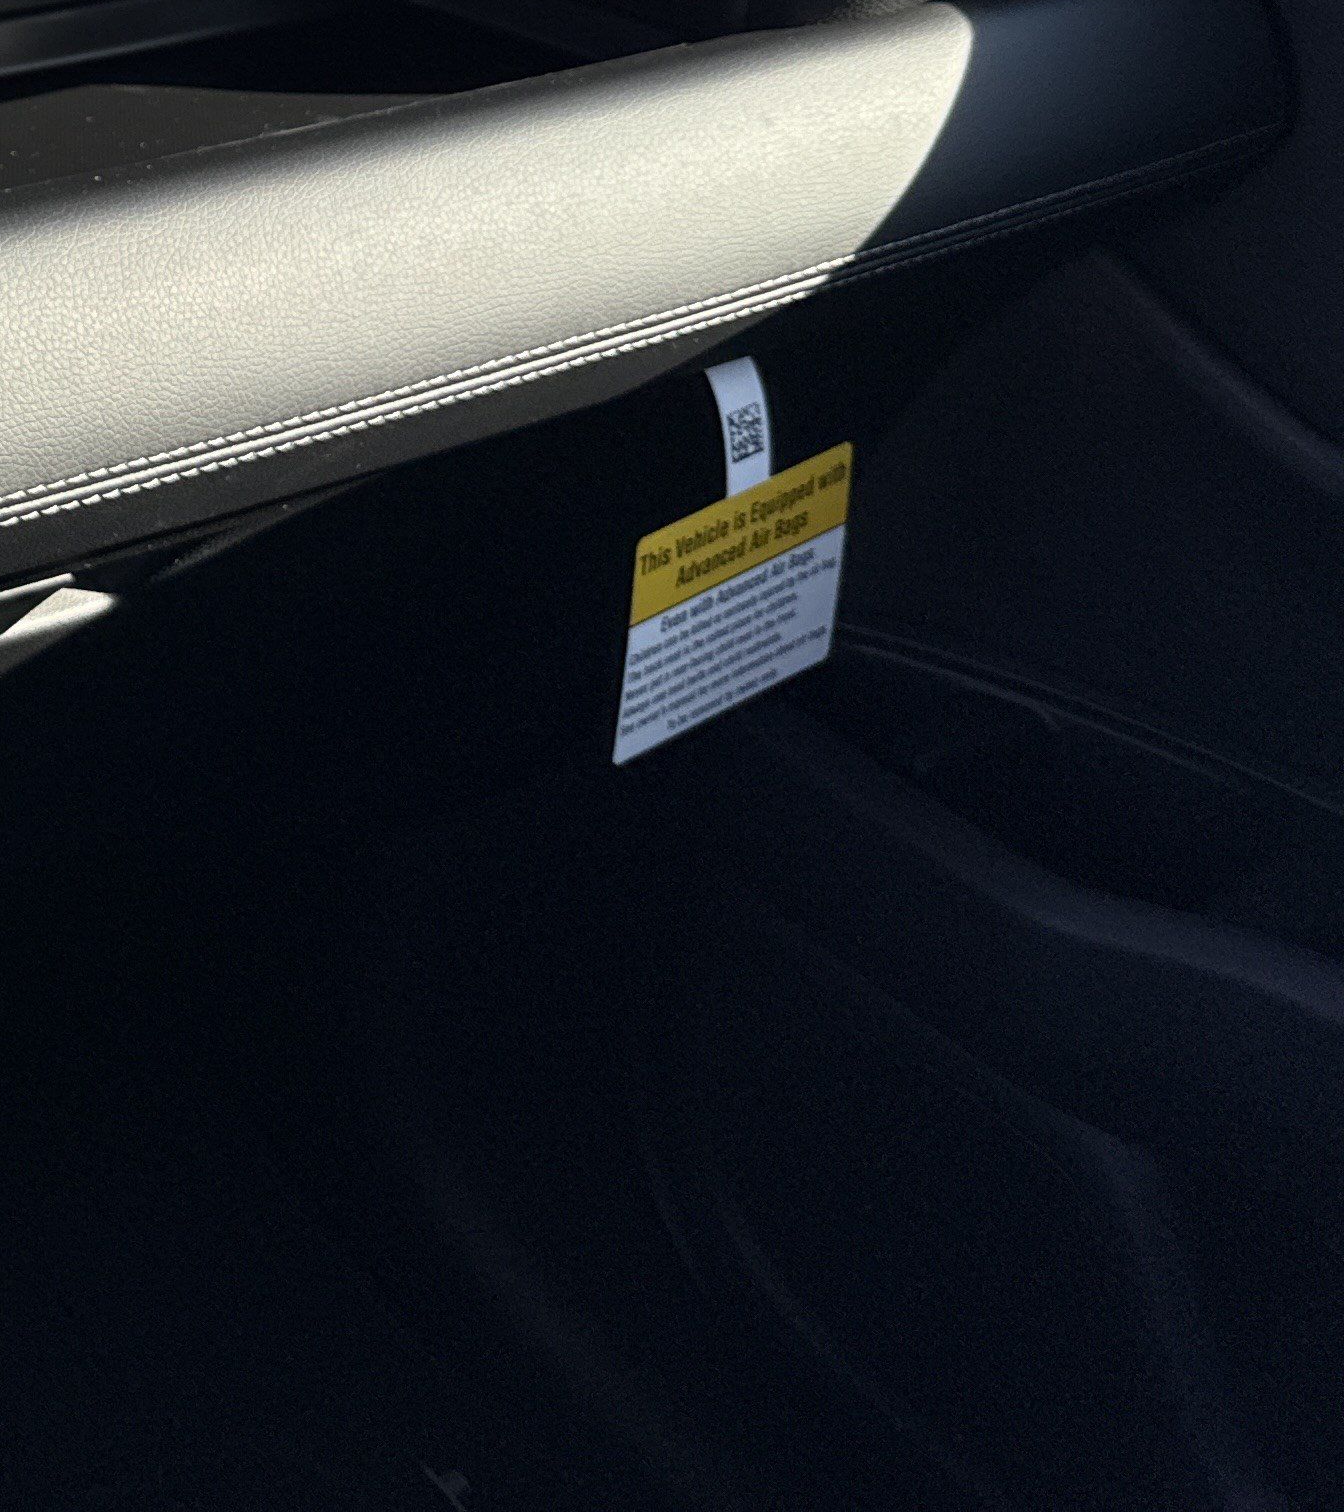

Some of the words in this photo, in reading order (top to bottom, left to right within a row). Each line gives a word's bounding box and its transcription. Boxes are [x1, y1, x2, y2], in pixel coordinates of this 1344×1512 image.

[640, 545, 672, 577] This
[675, 518, 730, 559] Vehicle
[733, 509, 747, 531] is
[750, 474, 815, 523] Equipped
[675, 536, 748, 587] Advanced
[750, 526, 772, 551] Air
[774, 510, 809, 540] Bags
